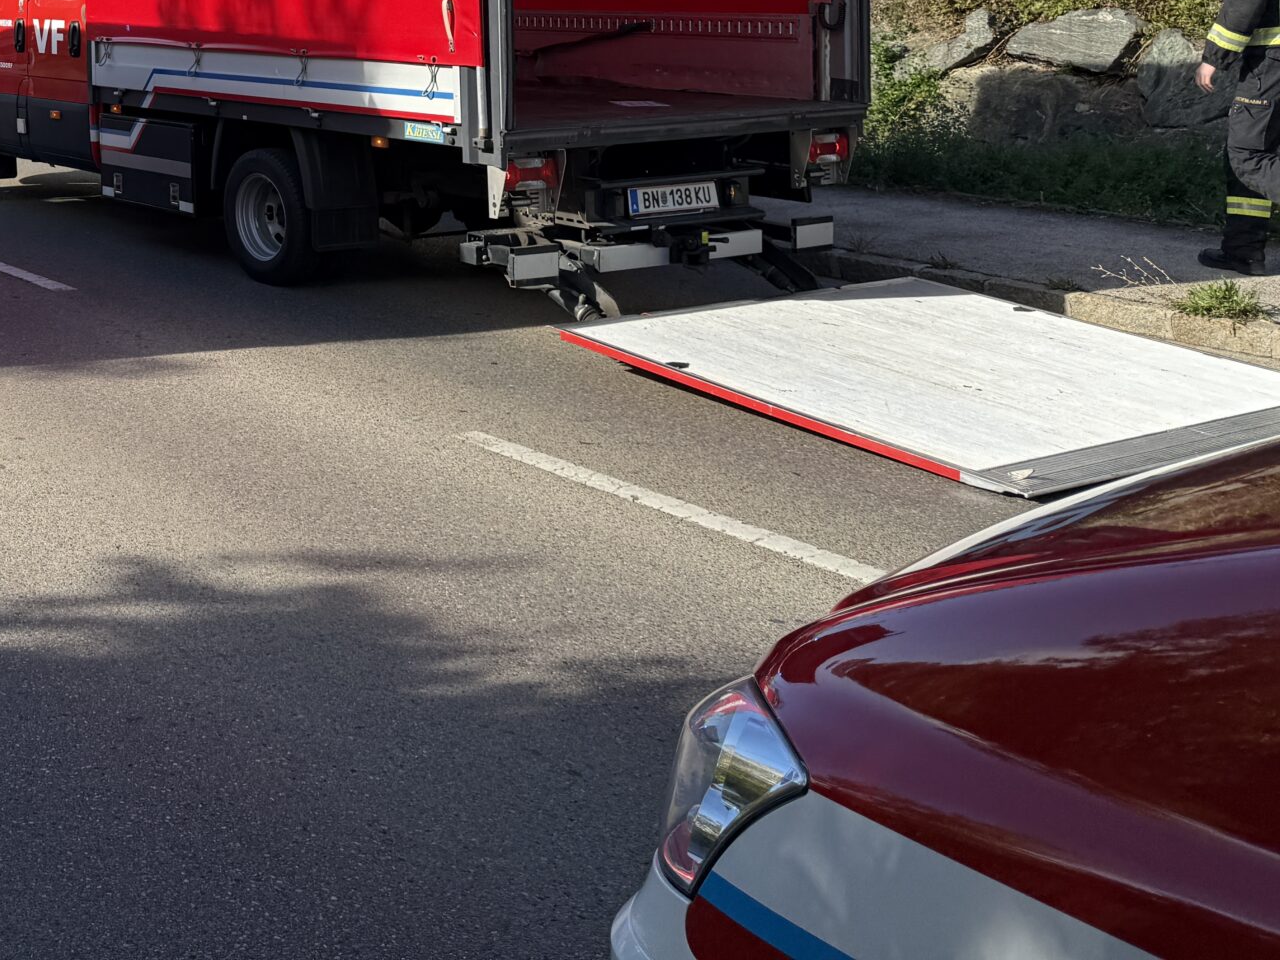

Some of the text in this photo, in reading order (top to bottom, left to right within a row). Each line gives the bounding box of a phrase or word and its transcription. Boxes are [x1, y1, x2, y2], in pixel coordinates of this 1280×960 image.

[32, 18, 65, 55] VF
[642, 185, 712, 209] BN 138 KU
